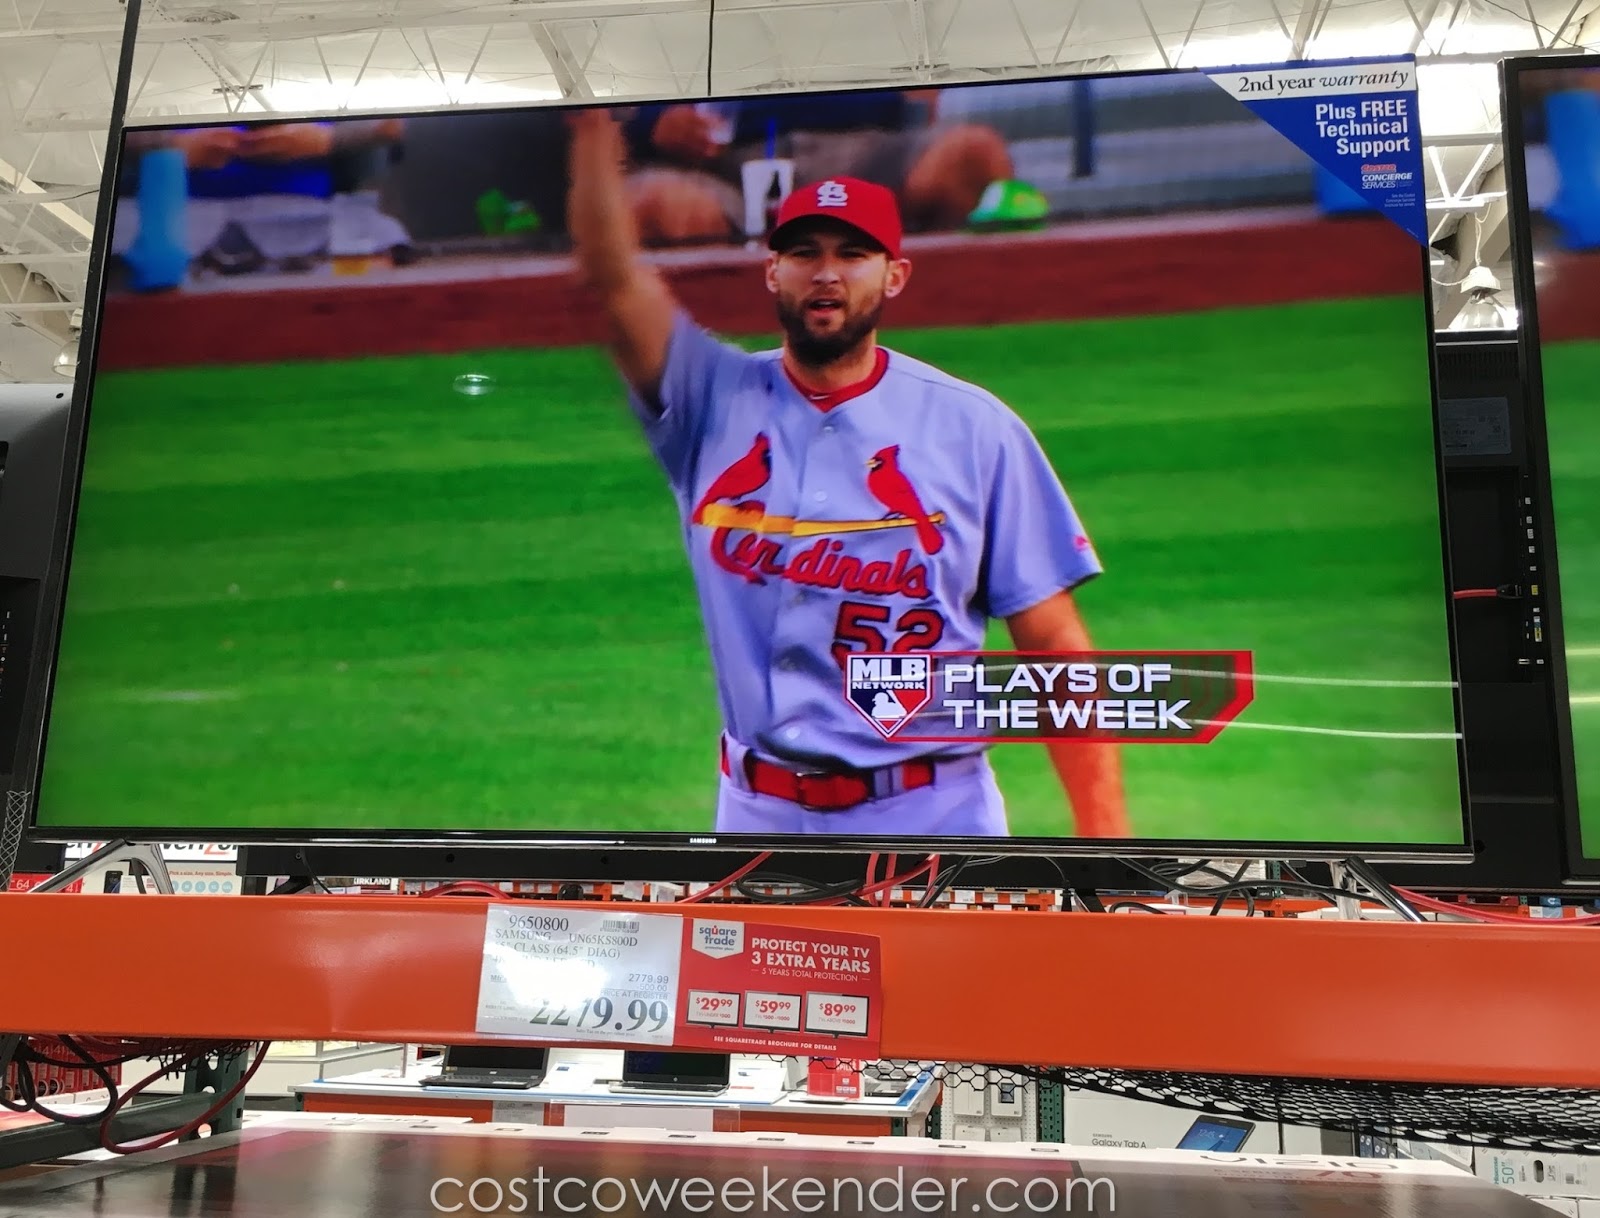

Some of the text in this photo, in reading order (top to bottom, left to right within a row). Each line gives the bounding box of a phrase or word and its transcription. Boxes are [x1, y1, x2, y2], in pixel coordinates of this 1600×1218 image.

[1238, 70, 1409, 95] 2nd year warranty
[1315, 99, 1408, 121] Plus FREE
[1315, 117, 1409, 138] Technical
[1336, 137, 1411, 158] Support
[1362, 172, 1413, 182] CONCIERGE
[1362, 180, 1396, 190] SERVICES
[831, 600, 945, 660] 52
[852, 658, 926, 681] MLB
[944, 663, 1172, 693] PLAYS OF
[851, 681, 926, 690] NETWORK
[943, 699, 1193, 730] THE WEEK
[509, 914, 569, 932] 9650800
[699, 925, 737, 937] square
[495, 928, 638, 947] SAMSUNG UN65KS800D
[704, 936, 735, 946] trade
[514, 942, 550, 954] CLASS
[553, 944, 584, 957] (64.5"
[587, 947, 621, 959] DIAG)
[751, 937, 870, 958] PROTECT YOUR TV
[751, 951, 871, 974] 3 EXTRA YEARS
[628, 973, 669, 984] 2779.99
[768, 968, 790, 977] YEARS
[791, 970, 812, 979] TOTAL
[813, 971, 858, 982] PROTECTION
[621, 990, 632, 998] AT
[634, 991, 669, 1000] REGISTER
[725, 1037, 766, 1045] SQUARETRADE
[767, 1039, 799, 1048] BROCHURE
[1092, 1138, 1147, 1149] Galaxy Tab A
